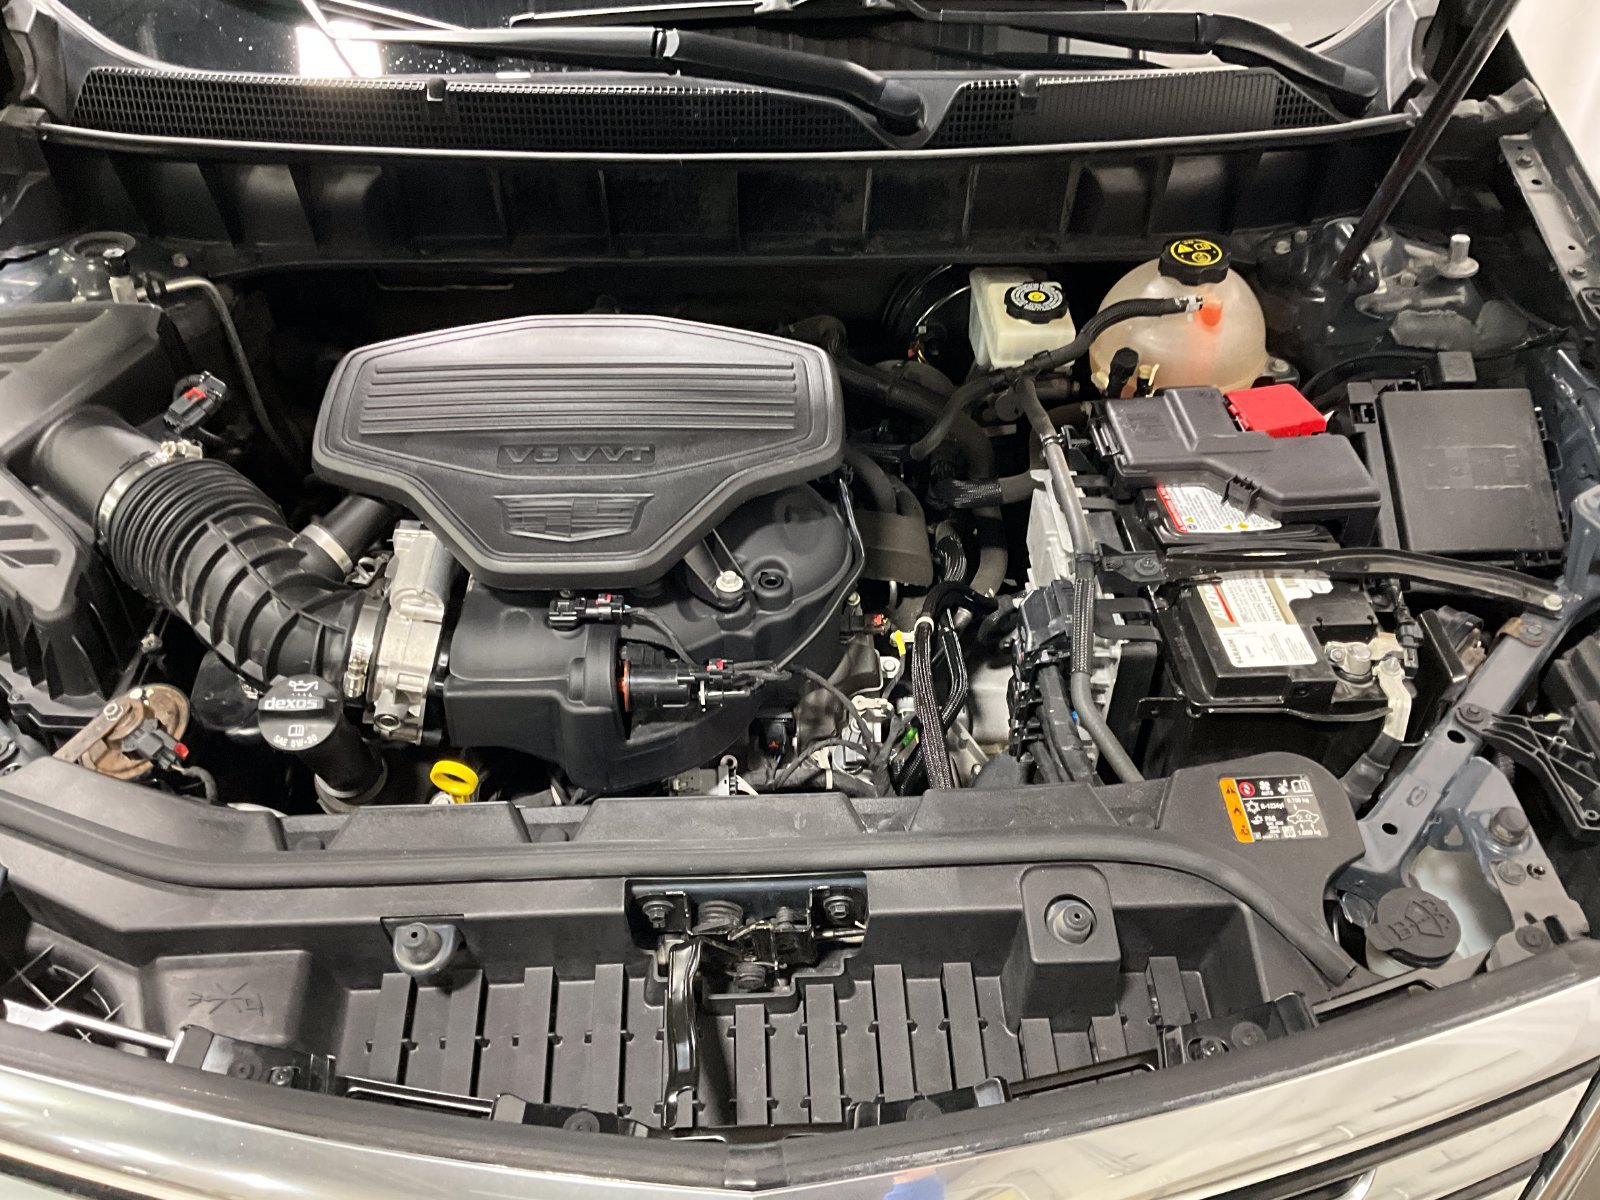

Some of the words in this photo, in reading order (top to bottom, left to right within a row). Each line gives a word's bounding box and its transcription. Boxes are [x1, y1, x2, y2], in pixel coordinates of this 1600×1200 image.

[569, 446, 650, 462] VVT
[264, 696, 319, 710] dexos
[273, 734, 289, 747] SAE
[290, 733, 318, 748] 5W-30
